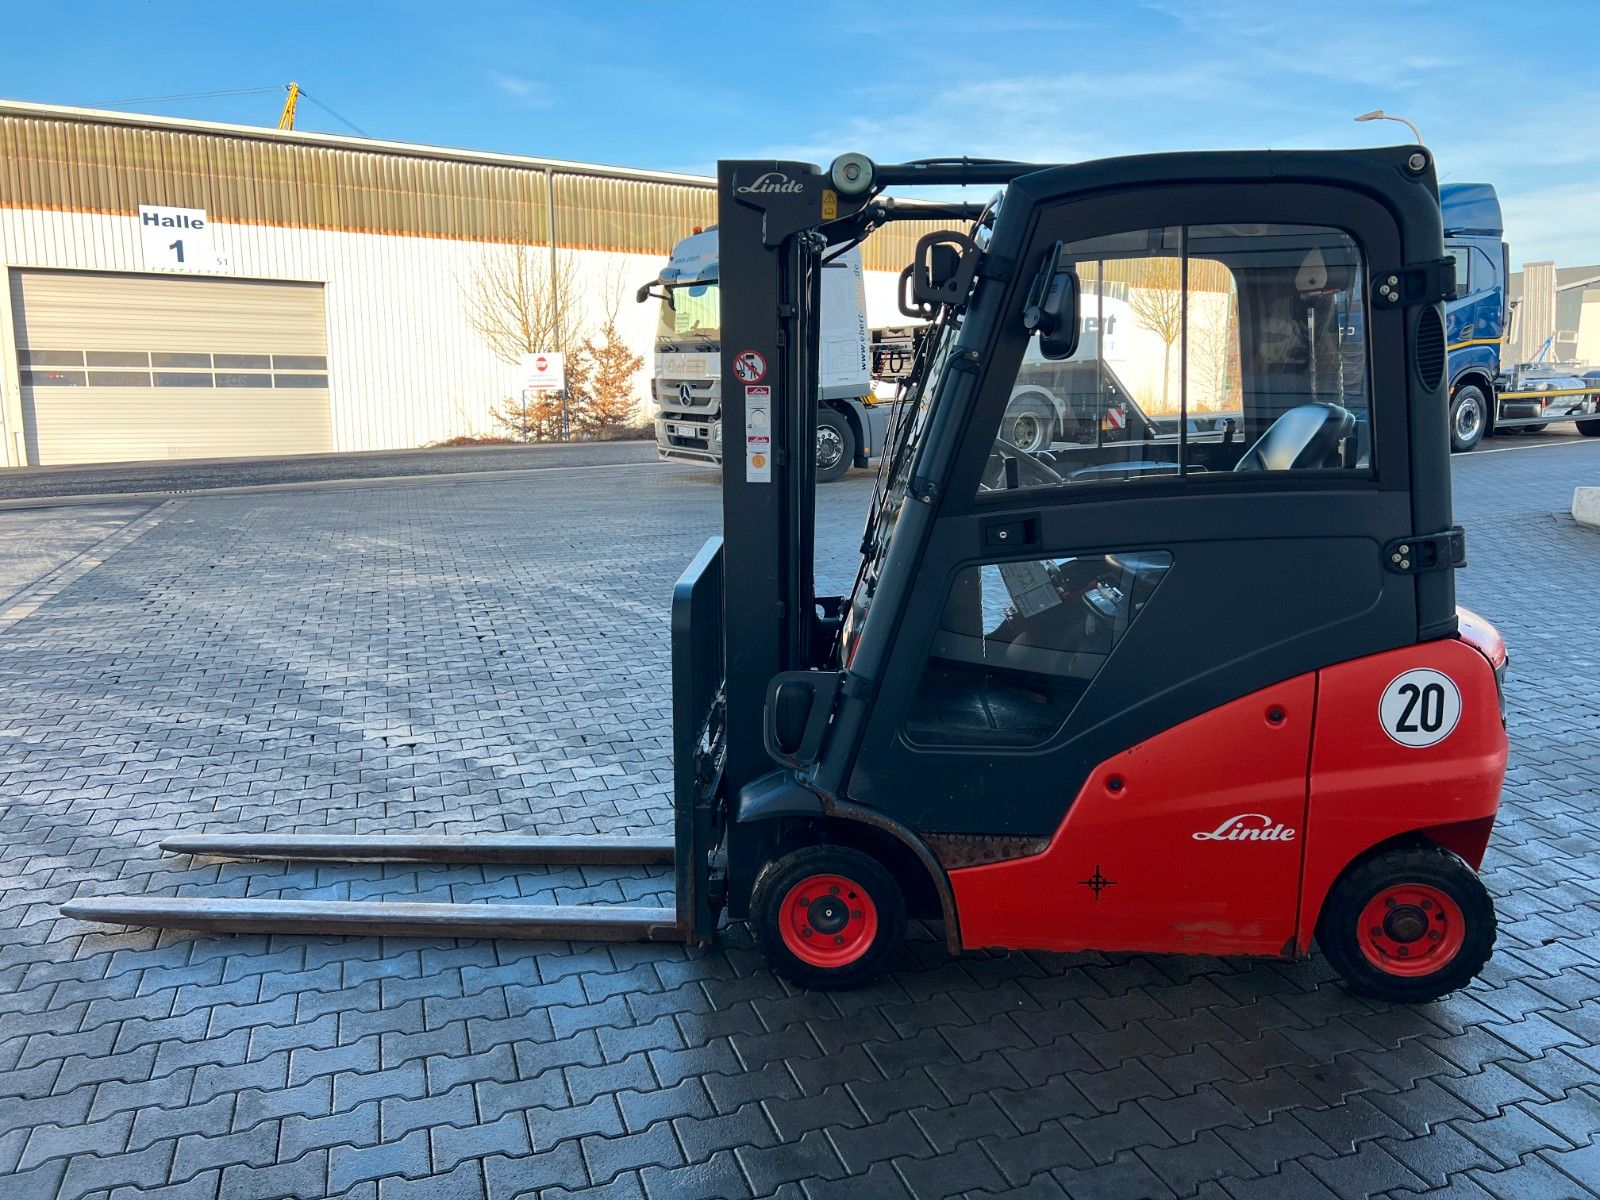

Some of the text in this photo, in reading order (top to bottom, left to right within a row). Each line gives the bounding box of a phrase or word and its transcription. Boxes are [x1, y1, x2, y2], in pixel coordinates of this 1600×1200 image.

[737, 172, 804, 193] Linde
[142, 212, 205, 229] Halle
[169, 240, 185, 263] 1
[1396, 682, 1445, 733] 20
[1192, 814, 1295, 842] Linde
